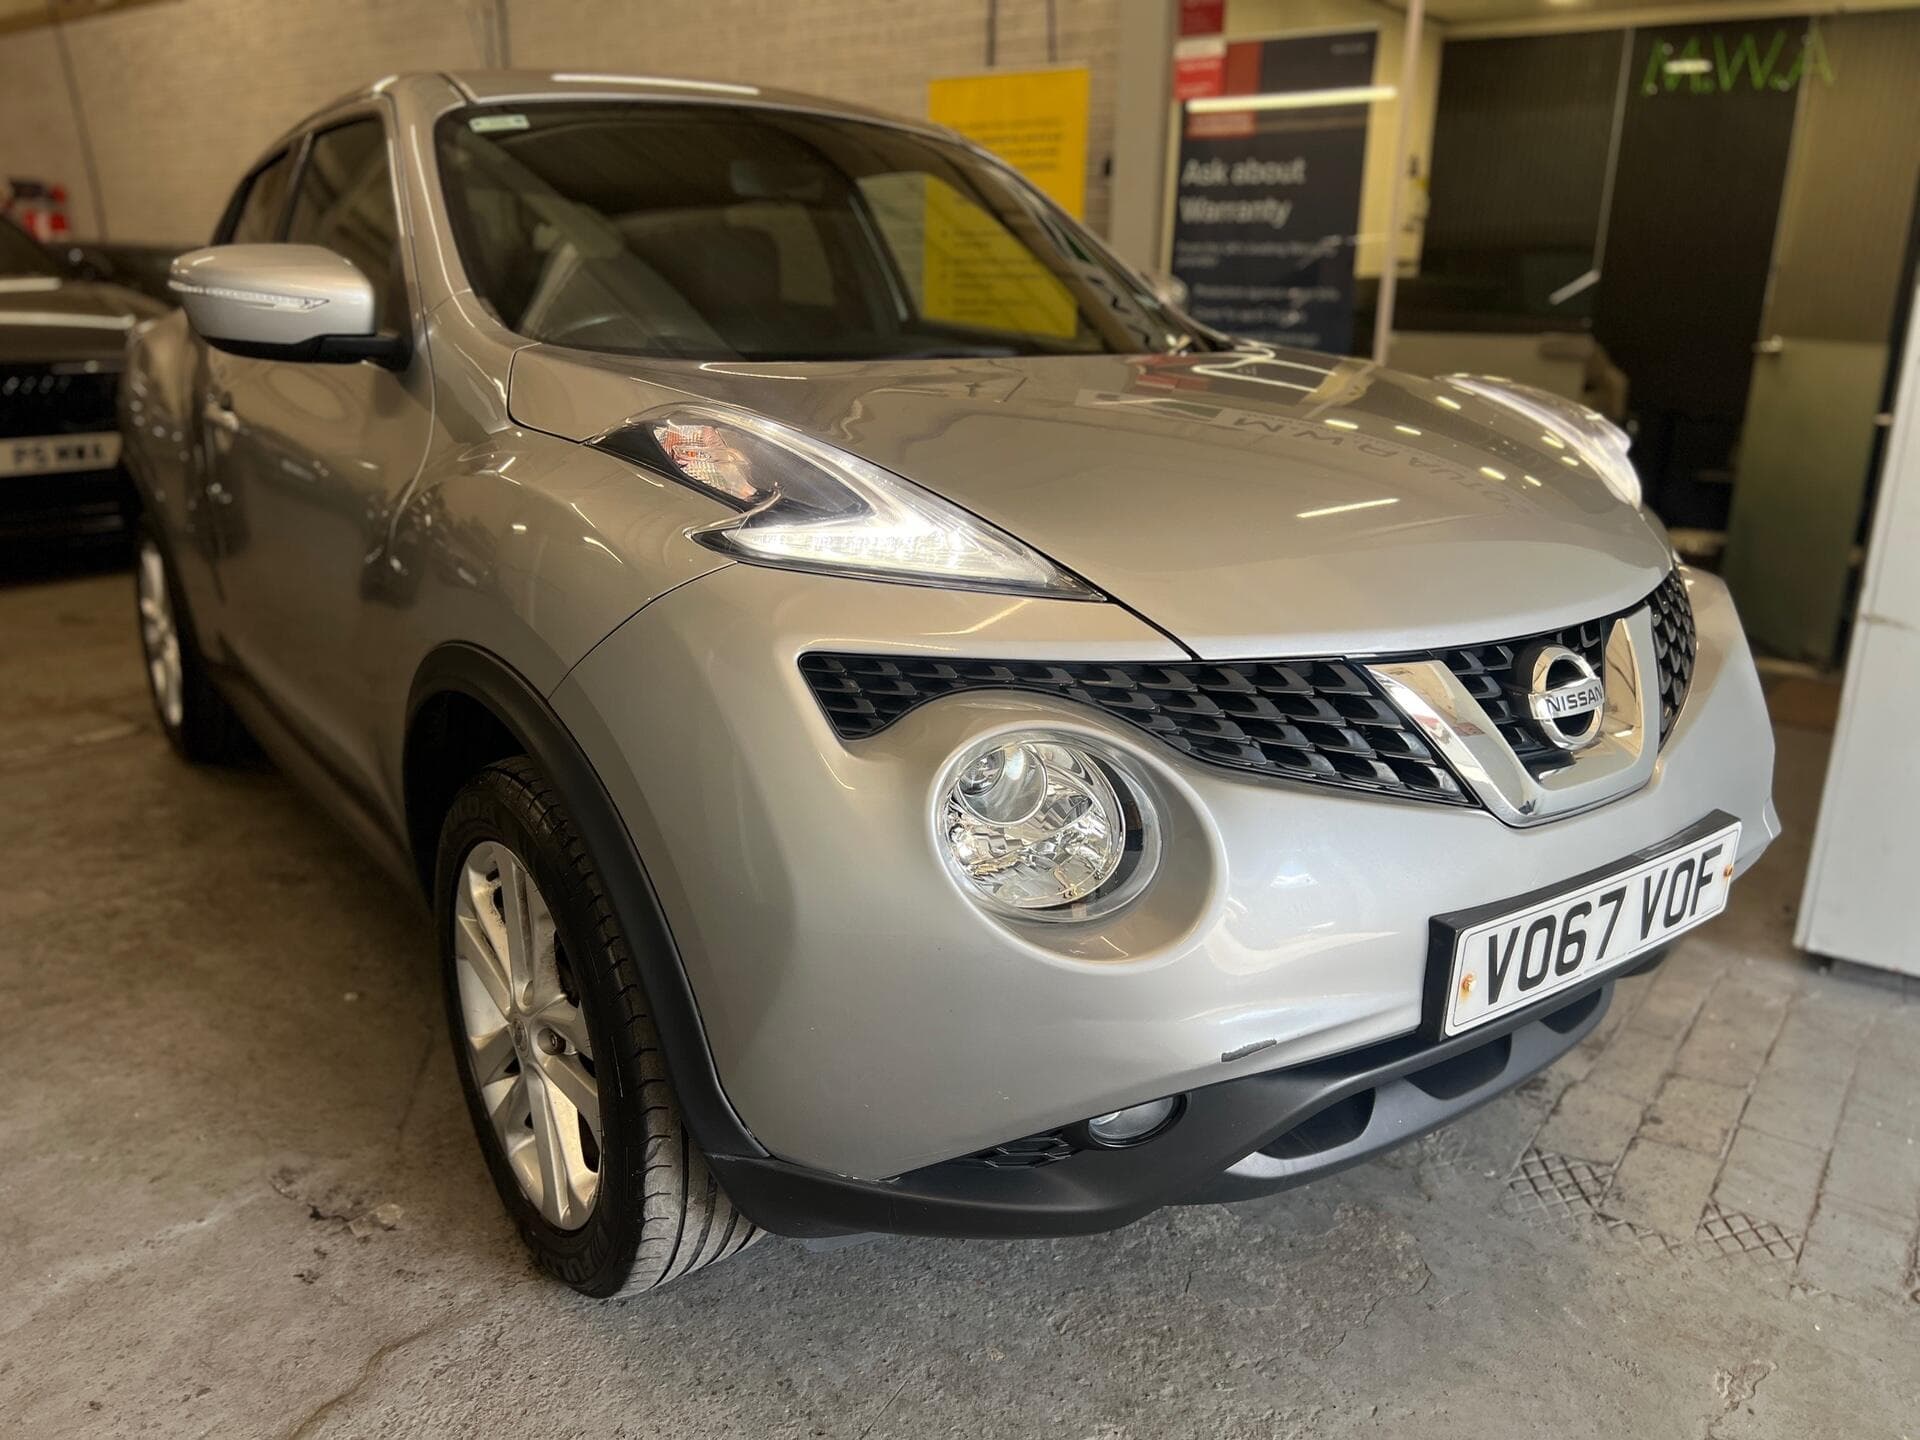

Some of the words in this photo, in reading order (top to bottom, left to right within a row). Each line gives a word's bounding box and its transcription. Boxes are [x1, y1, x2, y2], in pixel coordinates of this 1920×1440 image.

[1182, 159, 1229, 186] Ask
[1231, 157, 1306, 186] about
[1180, 196, 1292, 229] Warranty
[1545, 685, 1602, 712] NISSAN
[1487, 886, 1628, 1006] VO67
[1639, 843, 1724, 941] VOF
